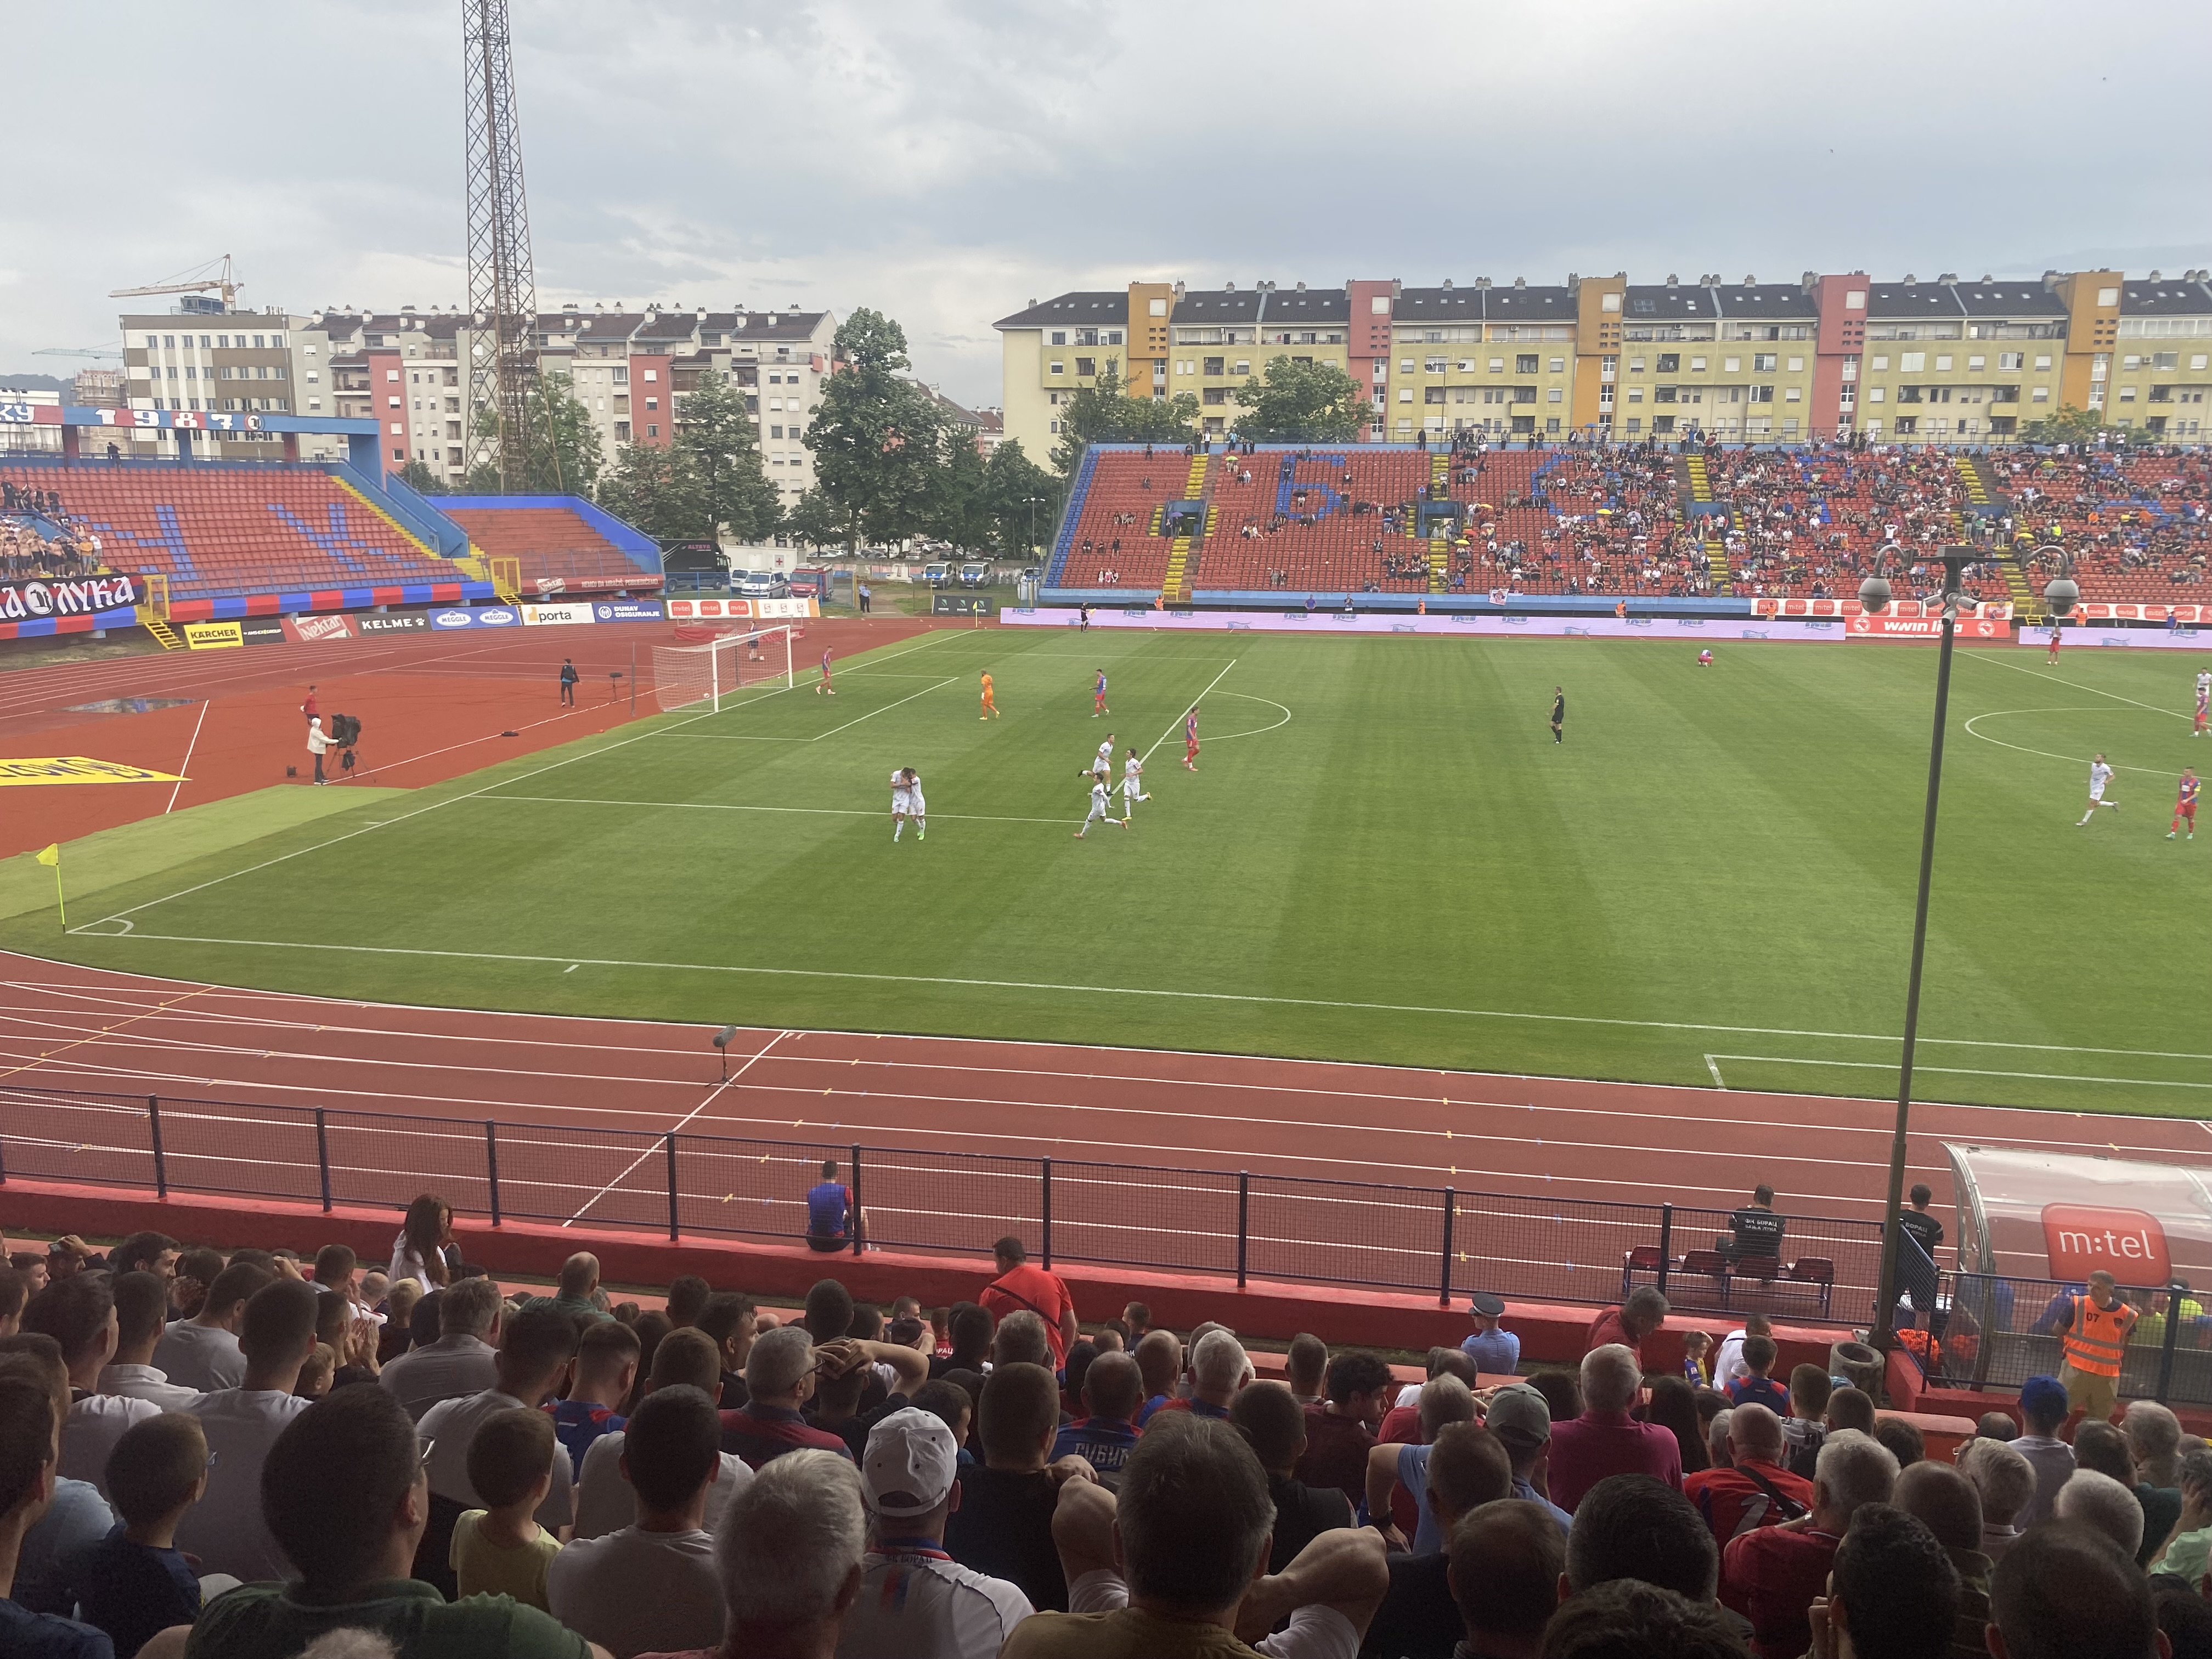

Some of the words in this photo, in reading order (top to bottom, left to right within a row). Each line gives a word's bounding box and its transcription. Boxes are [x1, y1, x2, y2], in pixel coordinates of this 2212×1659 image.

[539, 611, 572, 623] porta
[300, 615, 342, 641] Nektar
[362, 618, 413, 630] KELME
[1905, 1222, 1928, 1233] БОРАЦ
[2059, 1229, 2155, 1260] m:tel
[2086, 1312, 2100, 1323] 07
